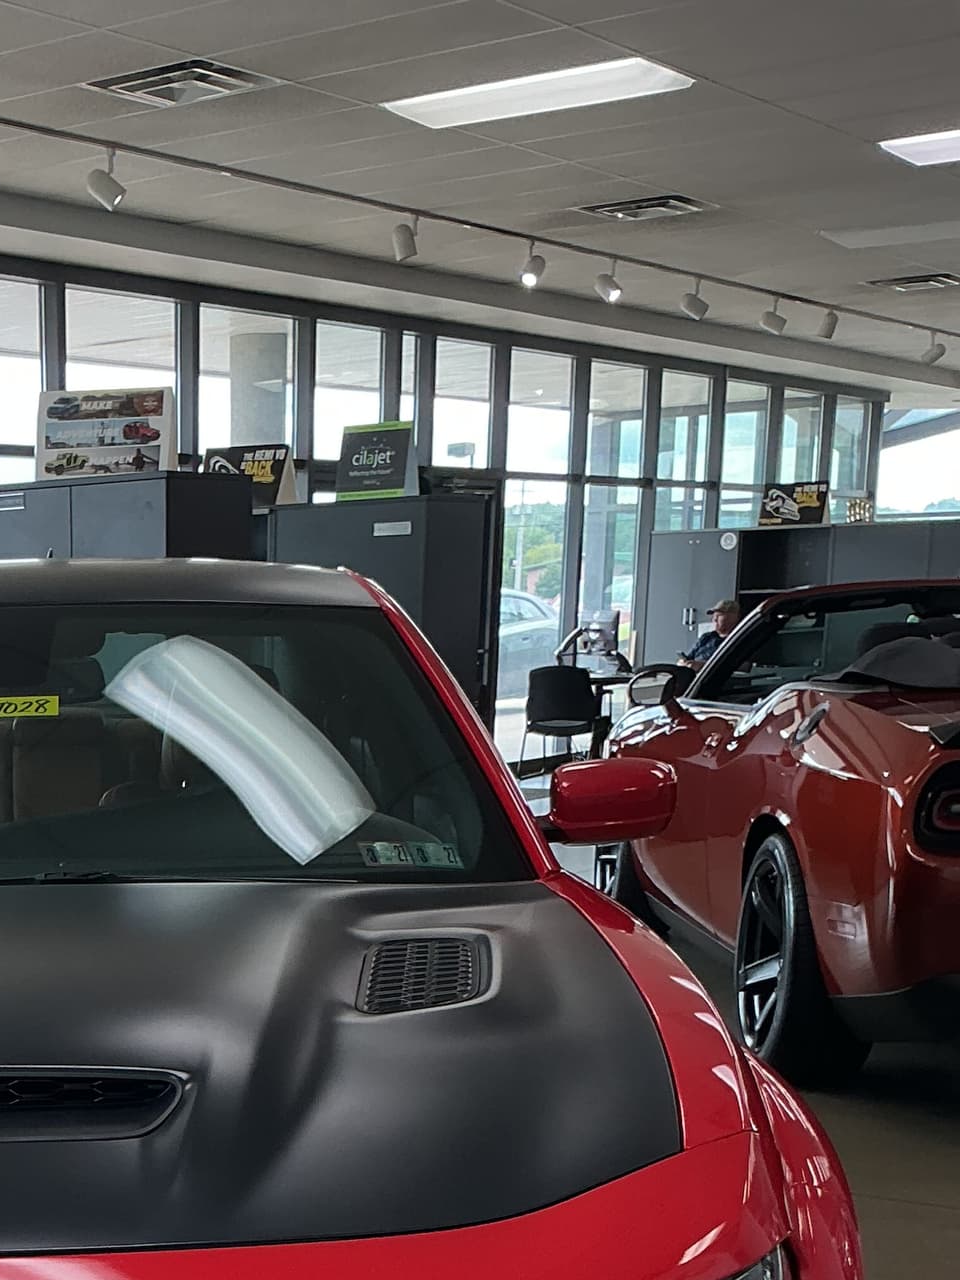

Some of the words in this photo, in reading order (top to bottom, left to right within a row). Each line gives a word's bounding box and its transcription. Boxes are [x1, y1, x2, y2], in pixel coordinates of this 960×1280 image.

[81, 400, 113, 410] MAKE
[352, 450, 392, 468] cilajet
[244, 460, 275, 477] BACK
